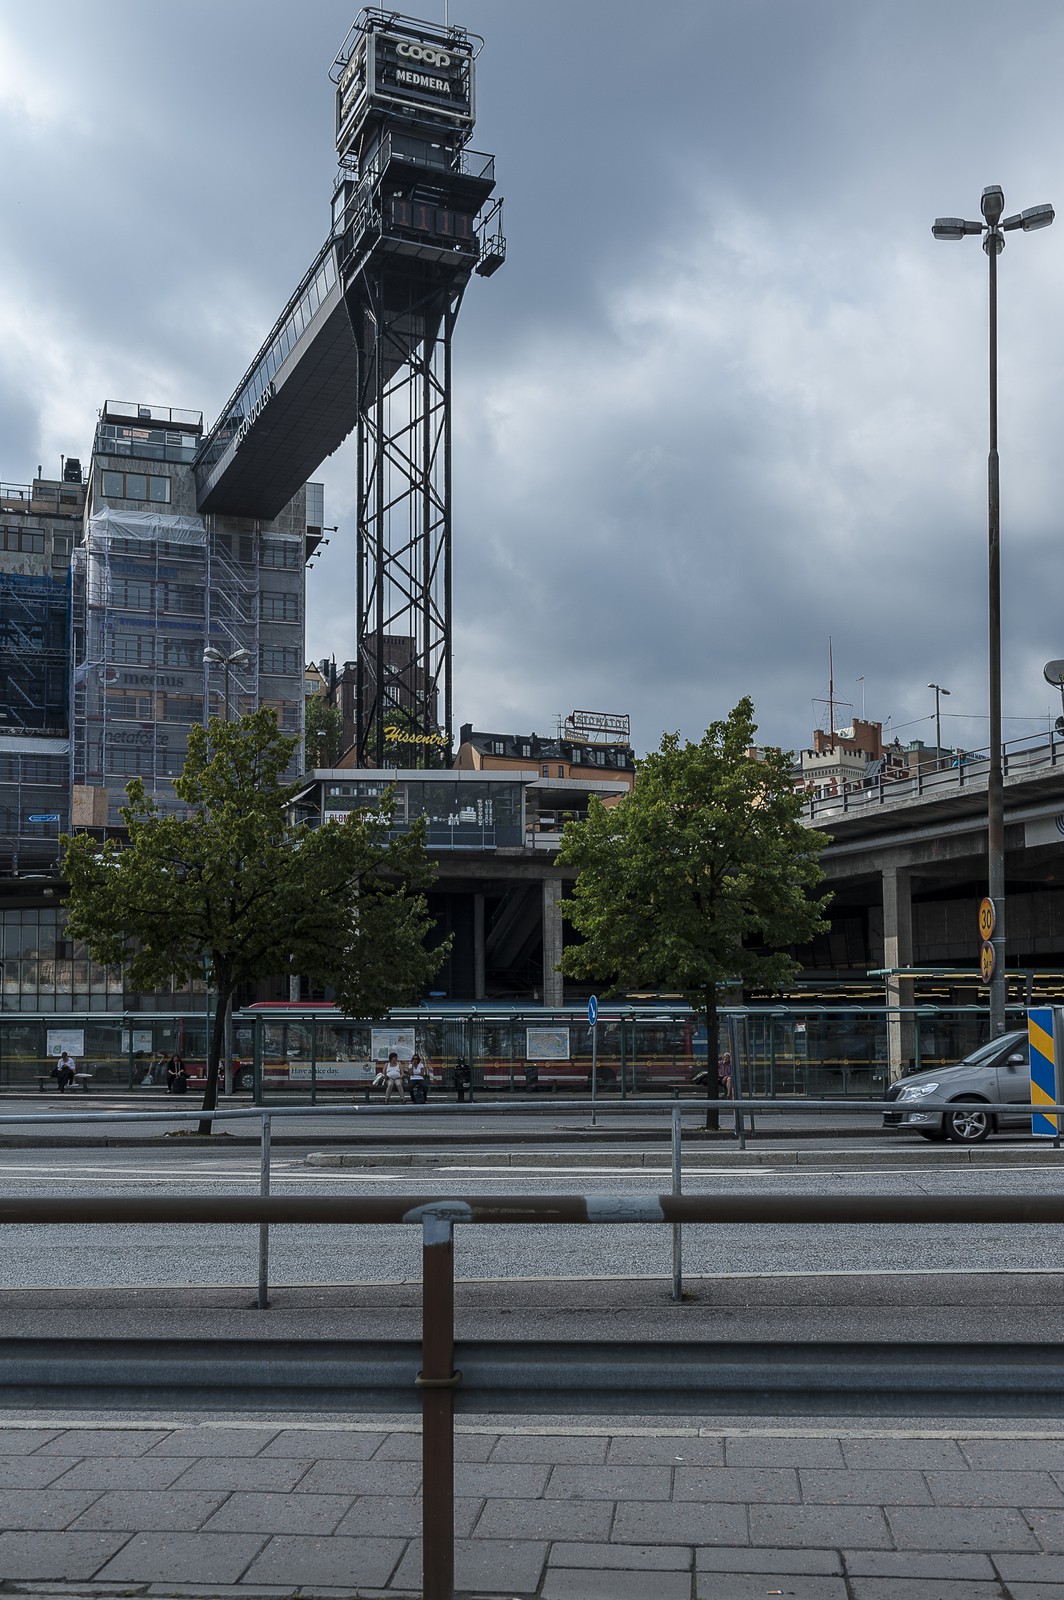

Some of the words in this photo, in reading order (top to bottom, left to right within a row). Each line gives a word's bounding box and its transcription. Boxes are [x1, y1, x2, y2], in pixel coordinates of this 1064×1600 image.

[396, 42, 451, 68] coop
[396, 69, 451, 92] MEDMERA
[238, 384, 272, 442] GONDOLEN
[383, 725, 449, 746] Hissentré
[982, 909, 992, 929] 30
